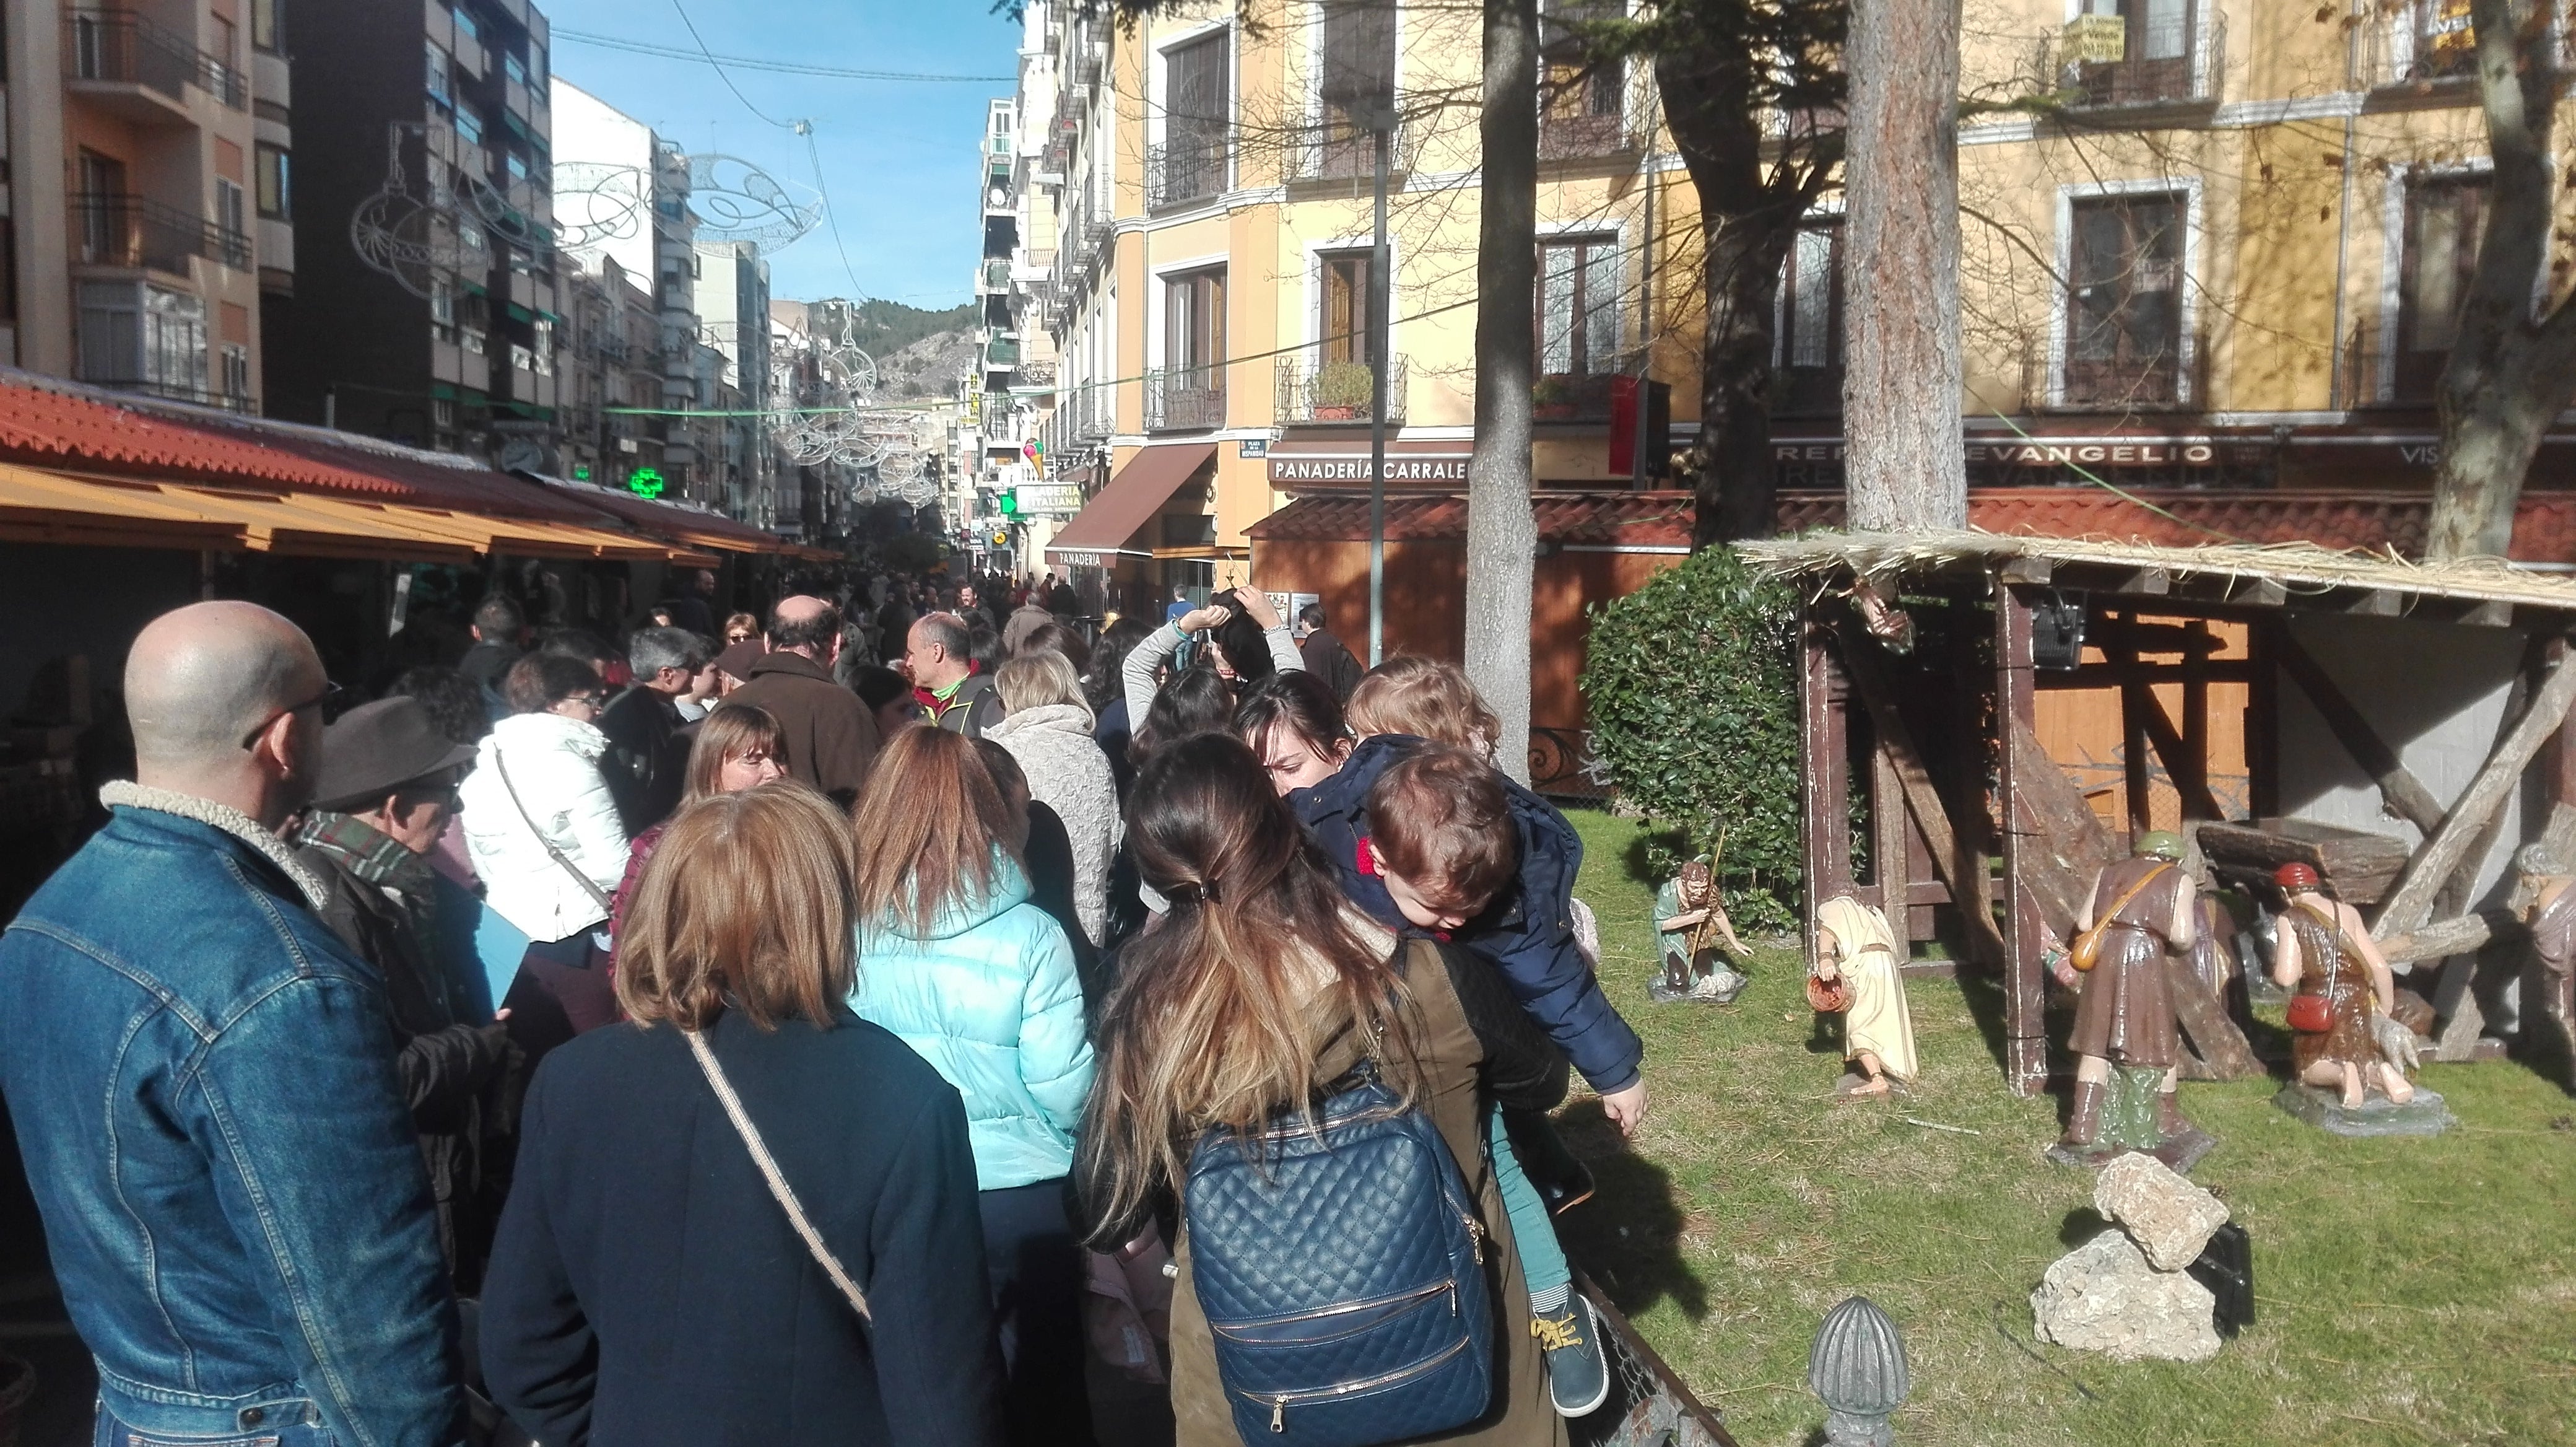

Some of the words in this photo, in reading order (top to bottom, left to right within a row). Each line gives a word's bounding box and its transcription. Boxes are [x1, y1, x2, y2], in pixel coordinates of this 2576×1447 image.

[1965, 445, 2213, 462] EVANGELIO
[2401, 446, 2439, 464] VIS
[1275, 460, 1372, 478] PANADERÍA
[1383, 462, 1470, 479] CARRALE
[1032, 496, 1081, 506] ITALIANA
